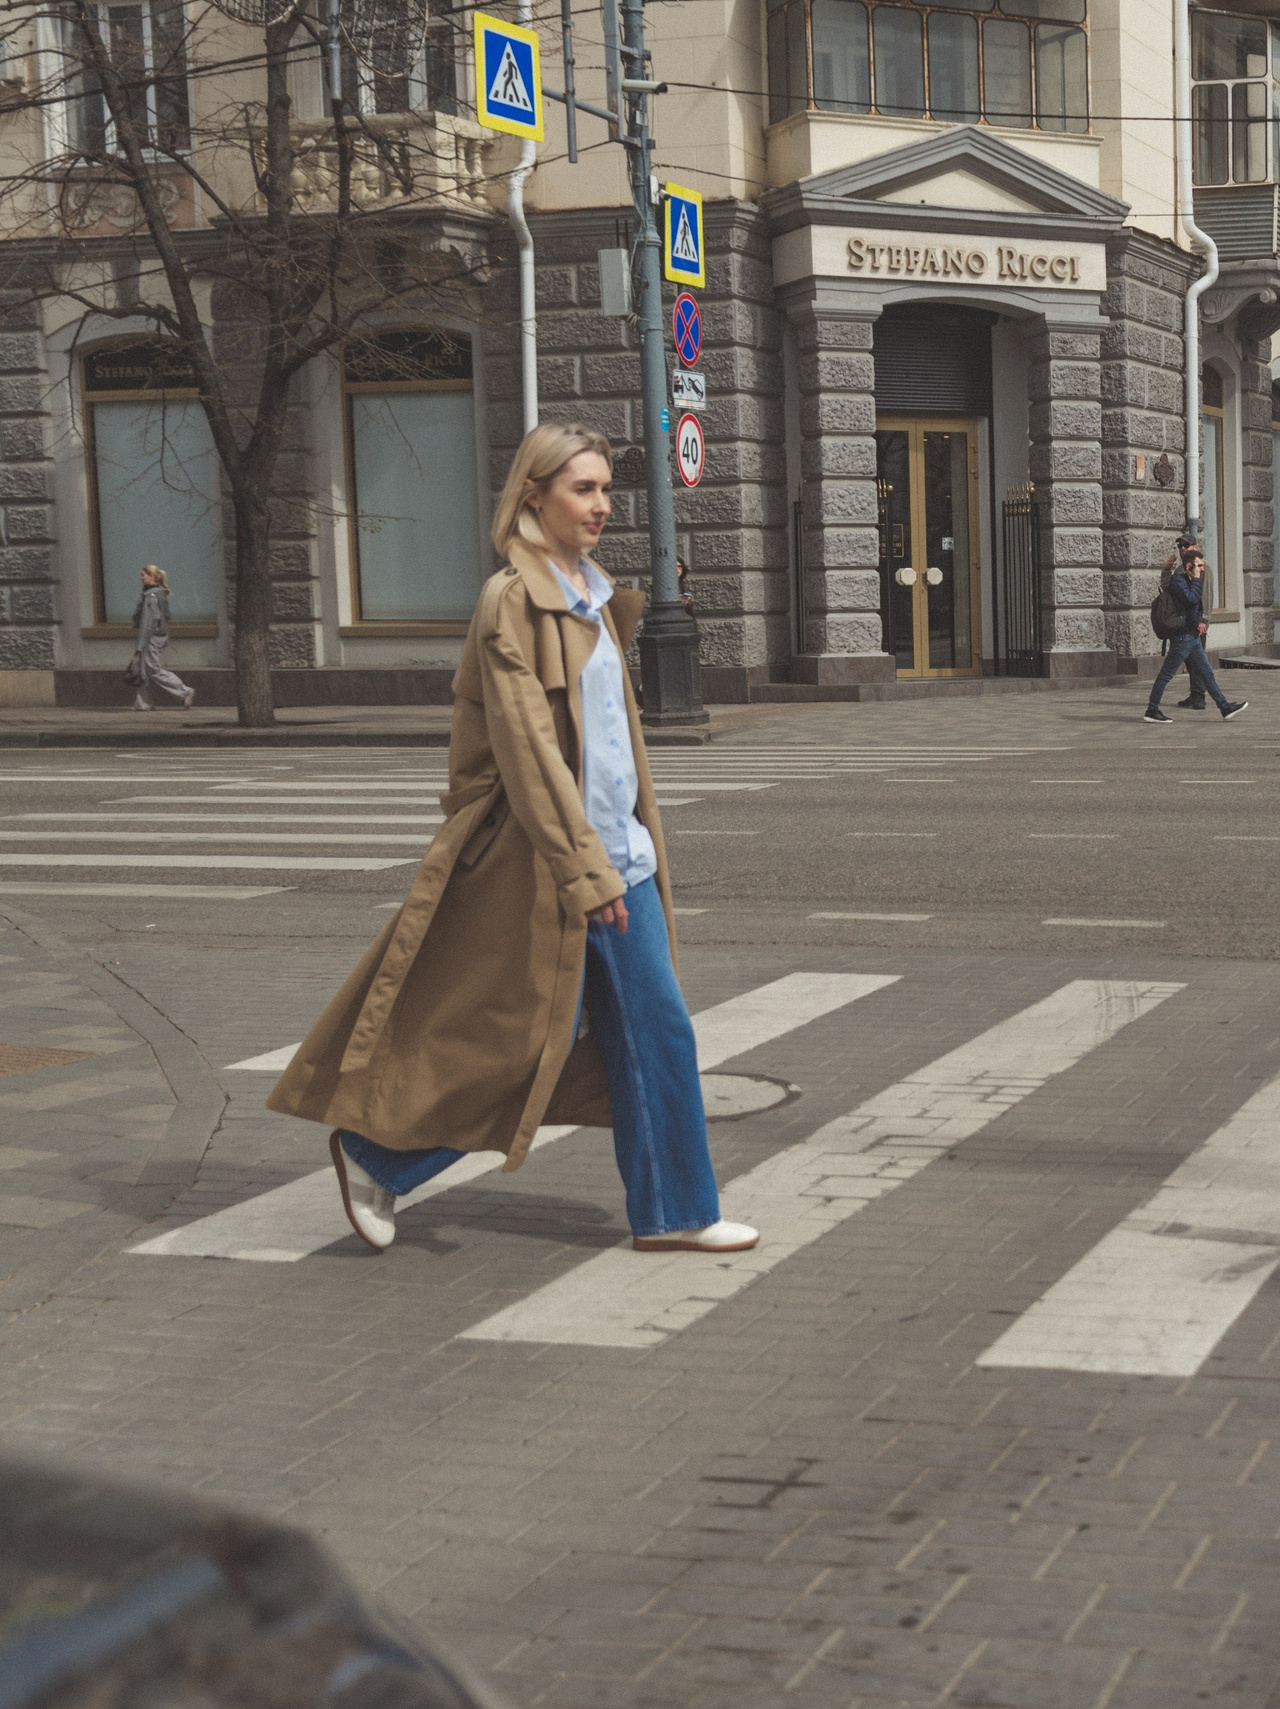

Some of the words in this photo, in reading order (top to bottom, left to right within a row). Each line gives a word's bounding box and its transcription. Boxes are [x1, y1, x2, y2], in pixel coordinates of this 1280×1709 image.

[847, 237, 989, 277] STEFANO
[997, 246, 1082, 282] RICCI
[94, 365, 152, 379] STEFANO
[682, 436, 698, 465] 40
